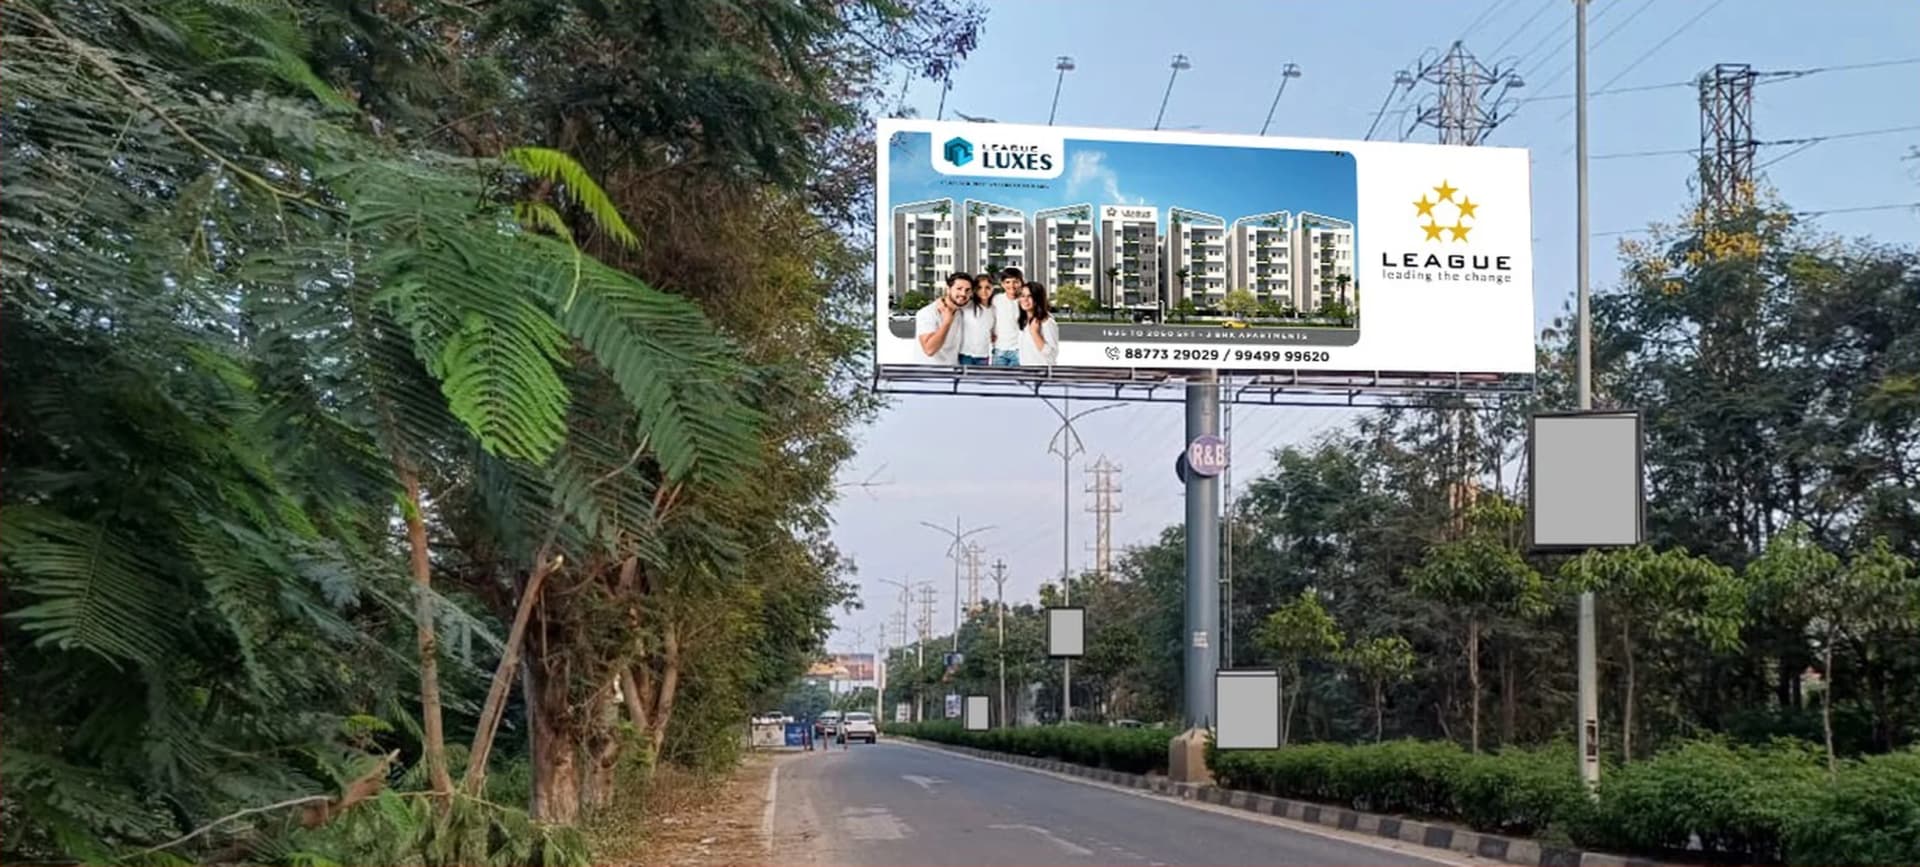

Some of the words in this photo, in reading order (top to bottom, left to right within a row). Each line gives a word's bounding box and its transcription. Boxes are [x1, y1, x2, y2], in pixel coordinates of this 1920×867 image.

[982, 143, 1039, 152] LEAGUE
[982, 152, 1053, 171] LUXES
[1382, 252, 1512, 271] LEAGUE
[1382, 269, 1432, 283] leading
[1438, 271, 1460, 281] the
[1464, 272, 1512, 286] change
[1125, 348, 1169, 359] 88773
[1173, 349, 1219, 361] 29029
[1223, 348, 1231, 362] /
[1234, 350, 1280, 362] 99499
[1284, 351, 1330, 362] 99620
[1192, 443, 1225, 466] R&B
